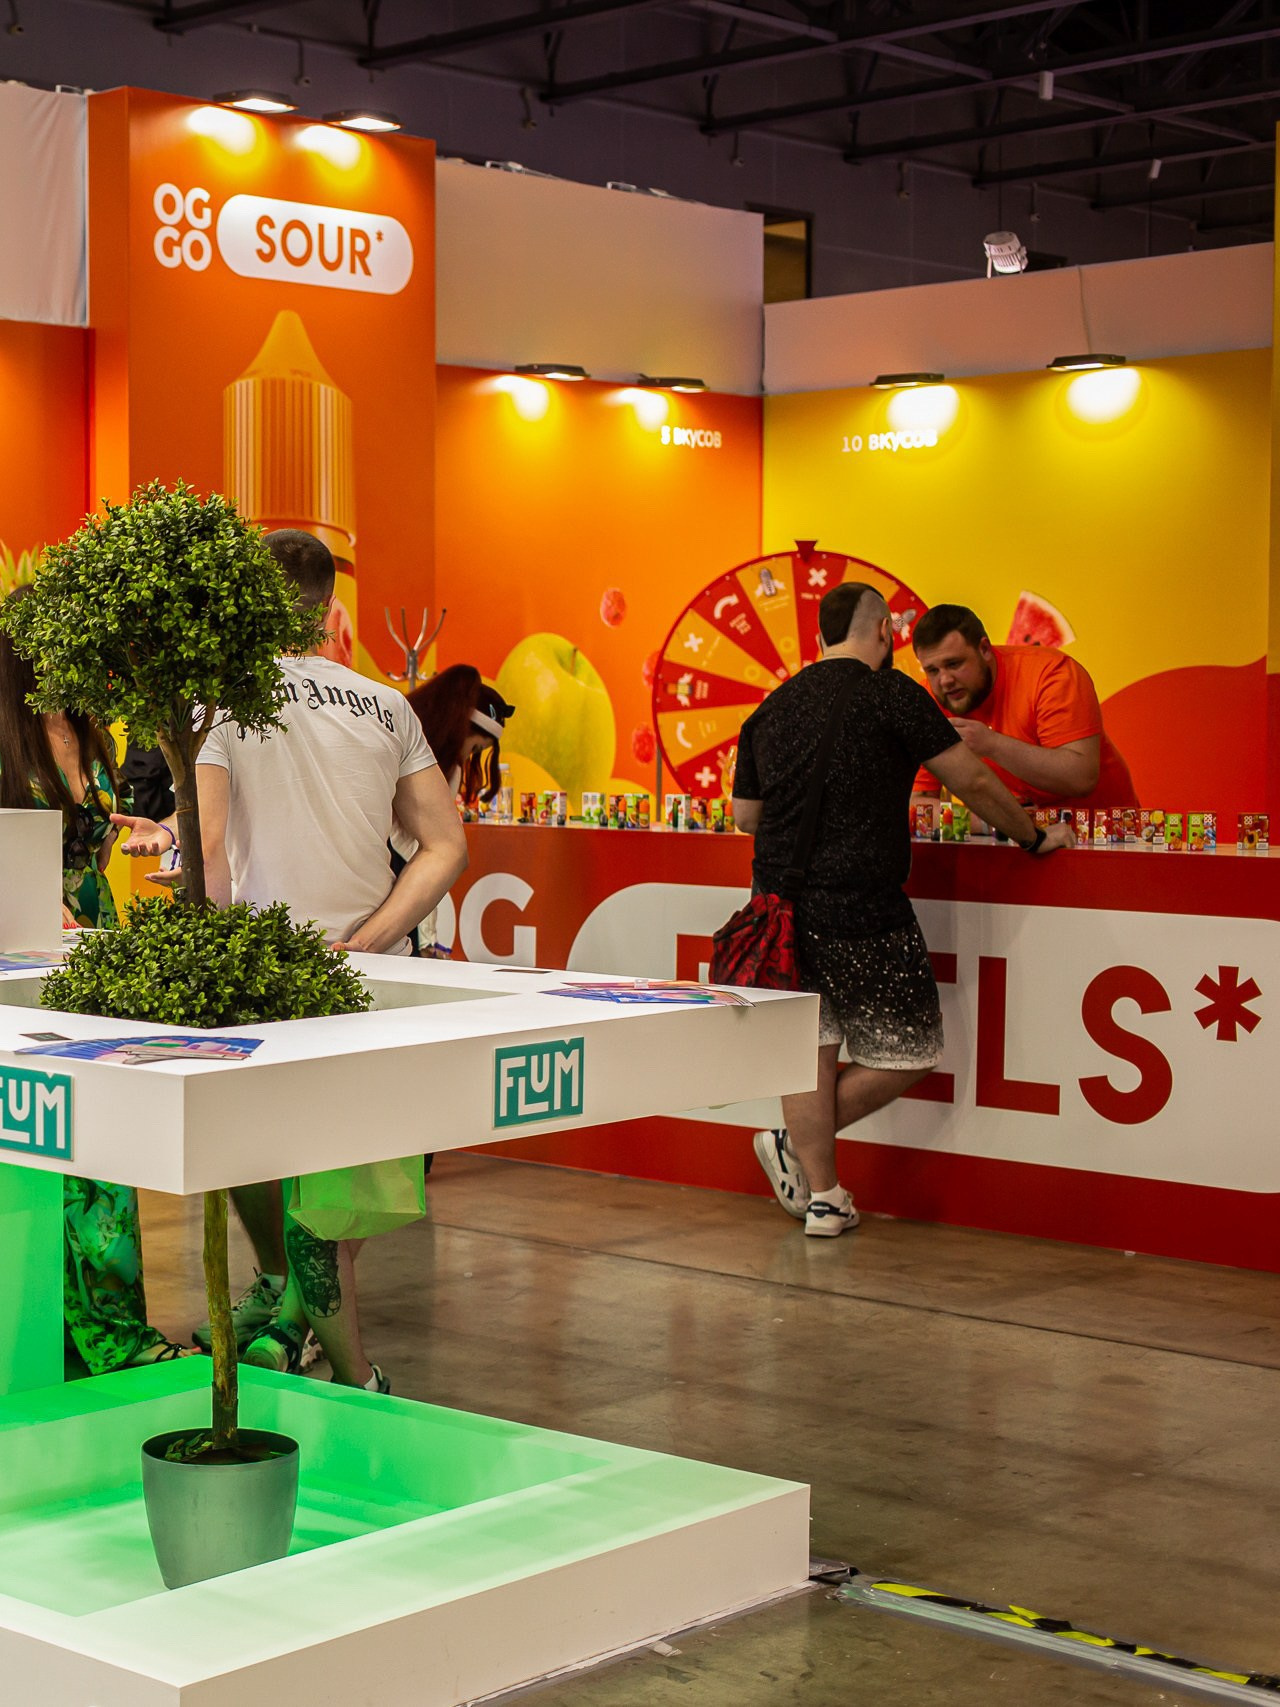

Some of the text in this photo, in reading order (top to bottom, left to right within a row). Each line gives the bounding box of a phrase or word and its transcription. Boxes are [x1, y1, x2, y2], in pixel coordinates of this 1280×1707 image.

[153, 182, 212, 229] OG
[153, 225, 212, 272] GO
[841, 434, 863, 453] 10
[301, 678, 395, 733] Angels
[499, 1047, 580, 1118] FLUM
